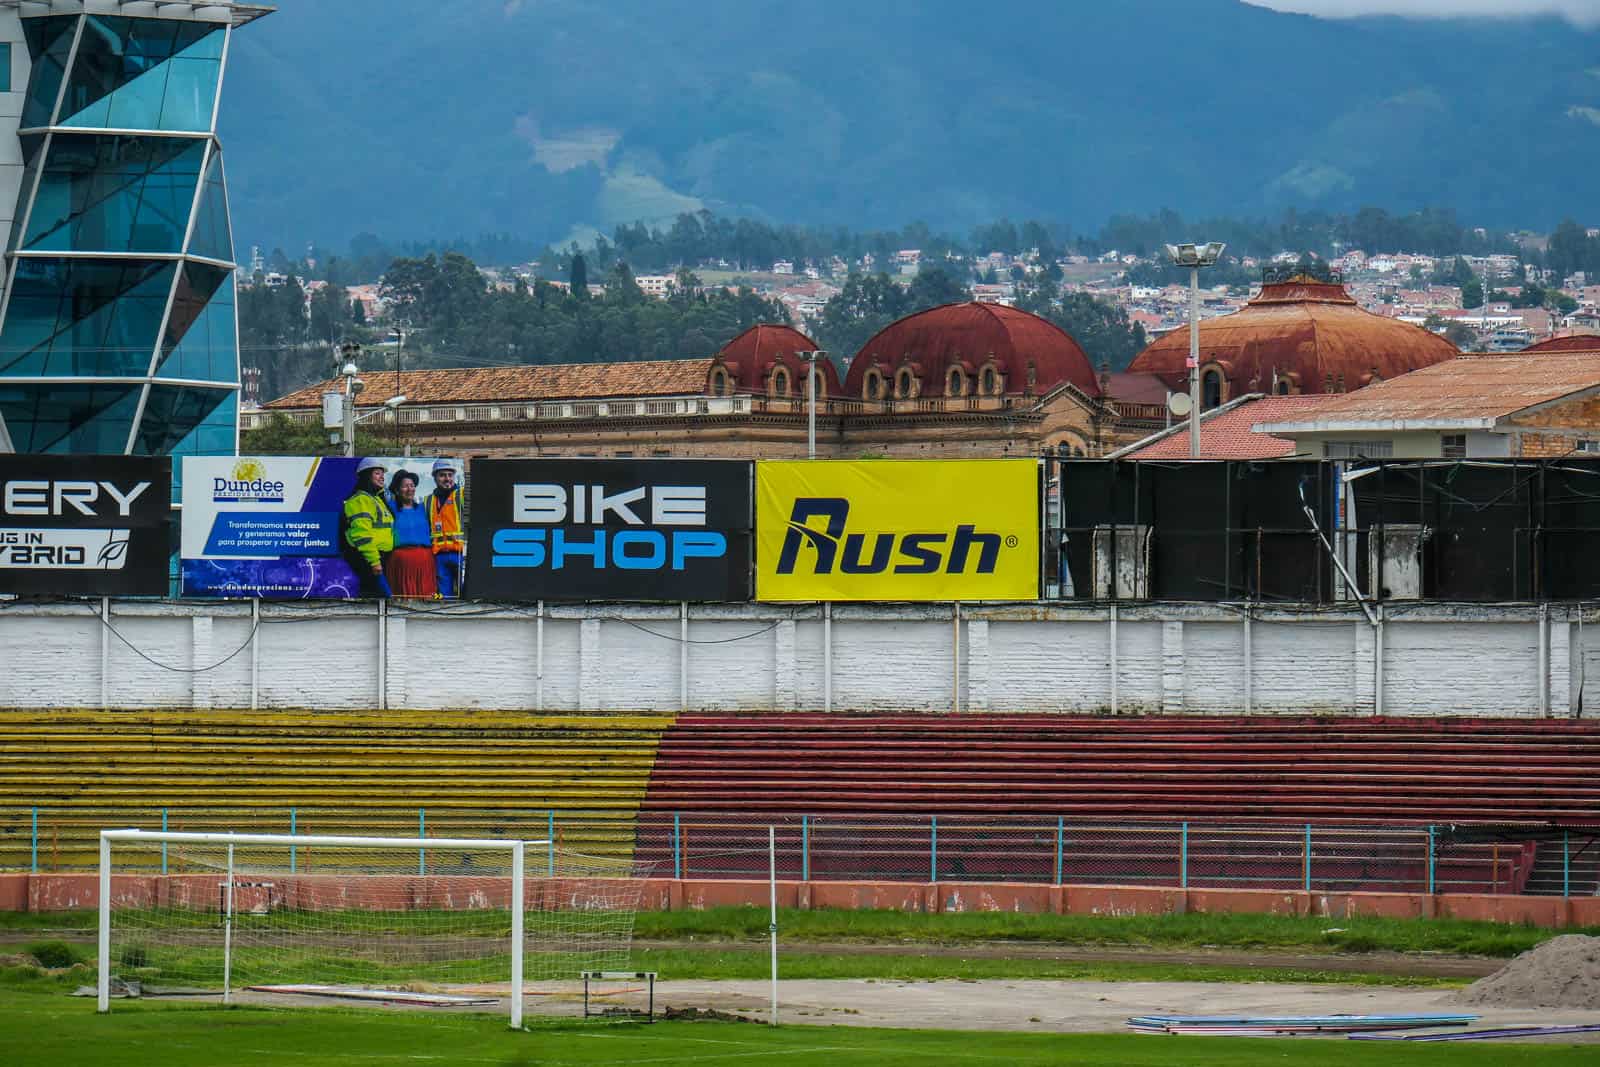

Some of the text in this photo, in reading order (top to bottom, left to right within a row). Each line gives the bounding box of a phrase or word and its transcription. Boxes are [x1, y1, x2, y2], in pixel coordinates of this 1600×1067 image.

[213, 478, 284, 492] Dundee
[4, 480, 151, 516] ERY
[513, 484, 706, 525] BIKE
[228, 521, 284, 529] Transformamos
[25, 532, 42, 544] IN
[287, 530, 309, 538] valor
[776, 497, 1001, 574] Rush
[237, 539, 272, 547] prosperar
[304, 539, 330, 548] juntos
[492, 529, 727, 570] SHOP
